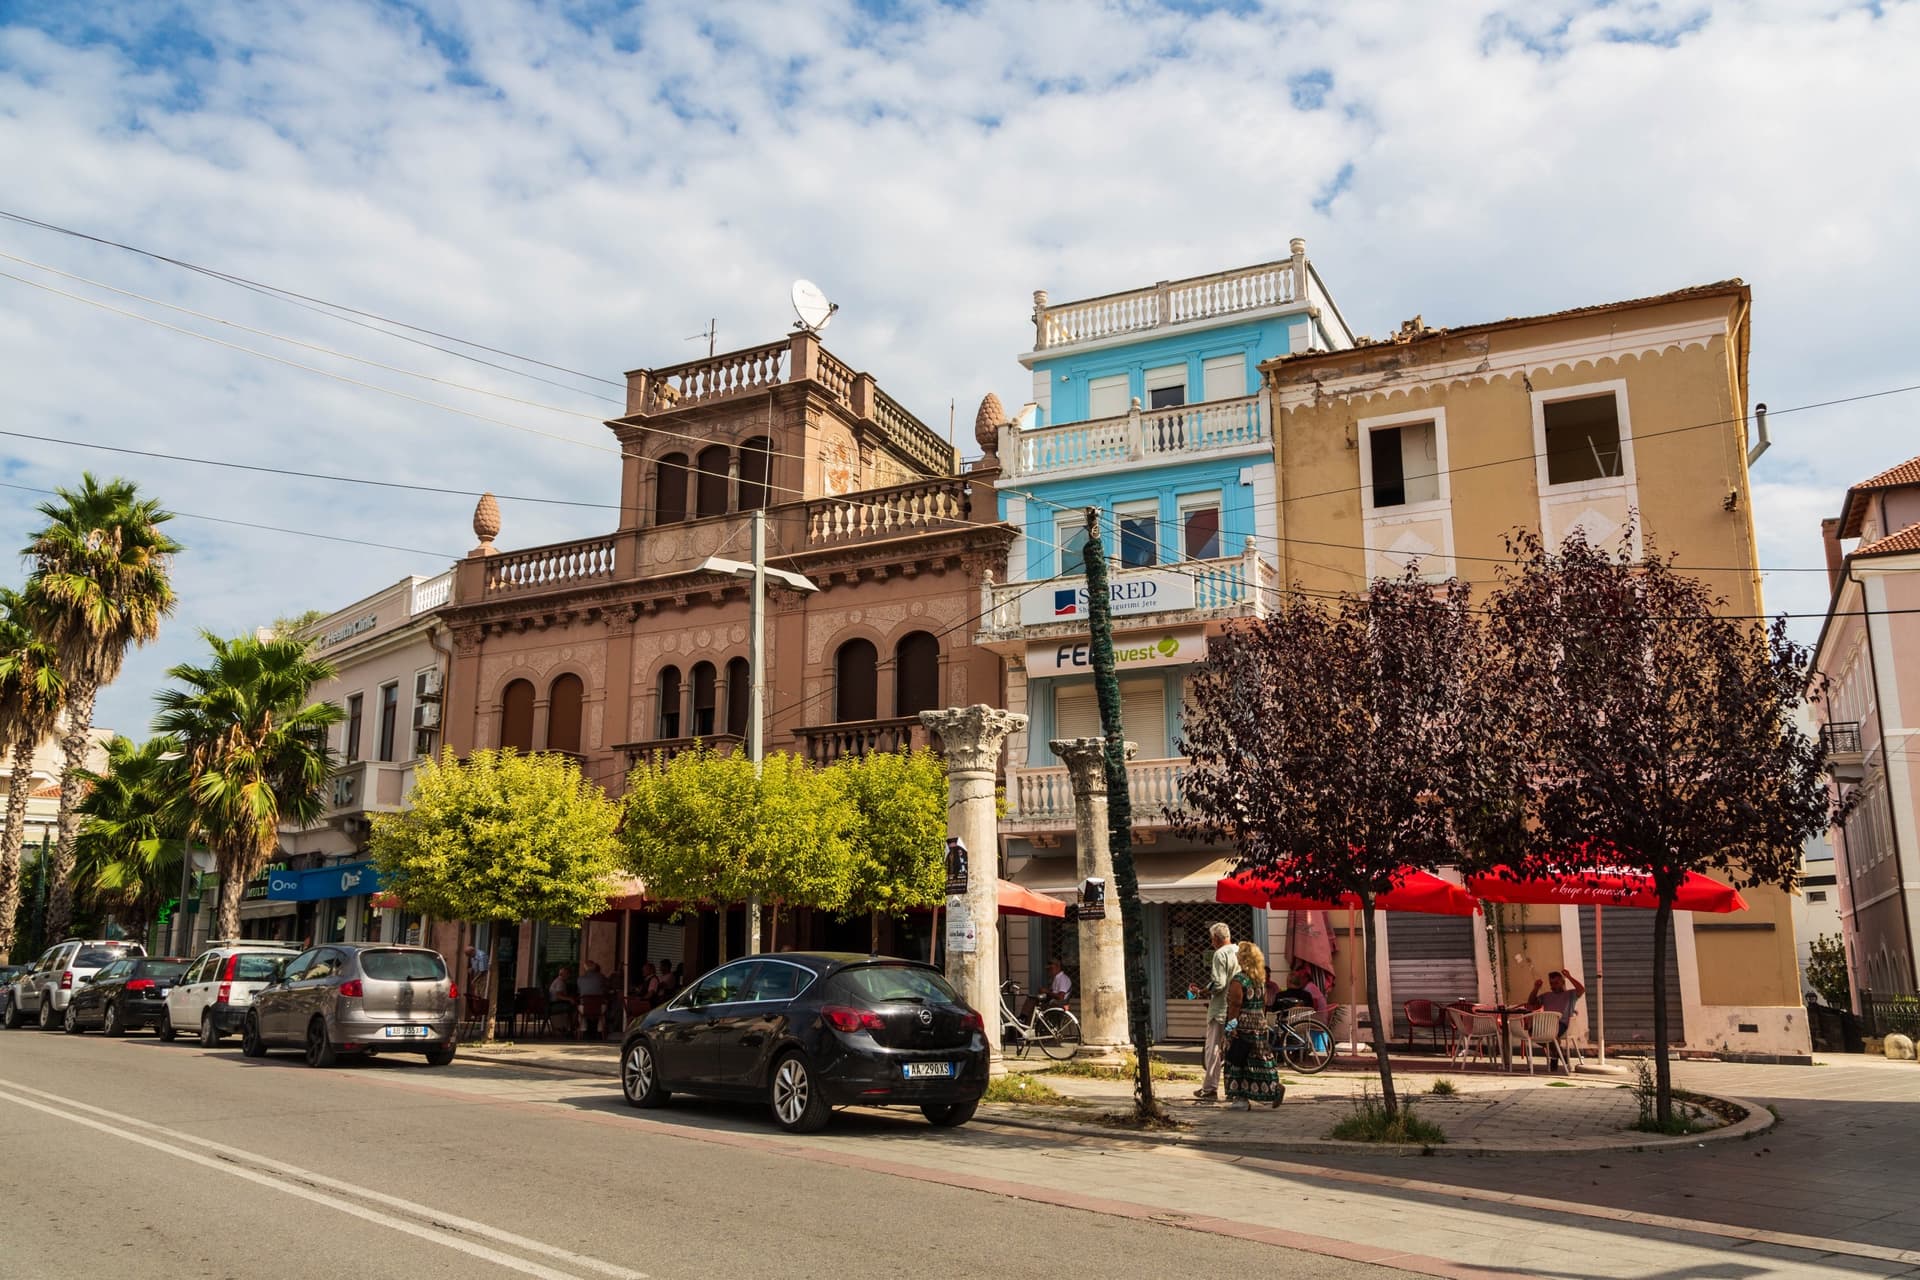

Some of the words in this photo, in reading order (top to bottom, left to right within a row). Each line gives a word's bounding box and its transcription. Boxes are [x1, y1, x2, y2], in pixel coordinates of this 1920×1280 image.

[1079, 580, 1157, 605] SRED
[1112, 645, 1156, 662] nvest
[272, 880, 297, 891] One
[911, 1063, 922, 1075] AA
[925, 1063, 949, 1075] 290XS
